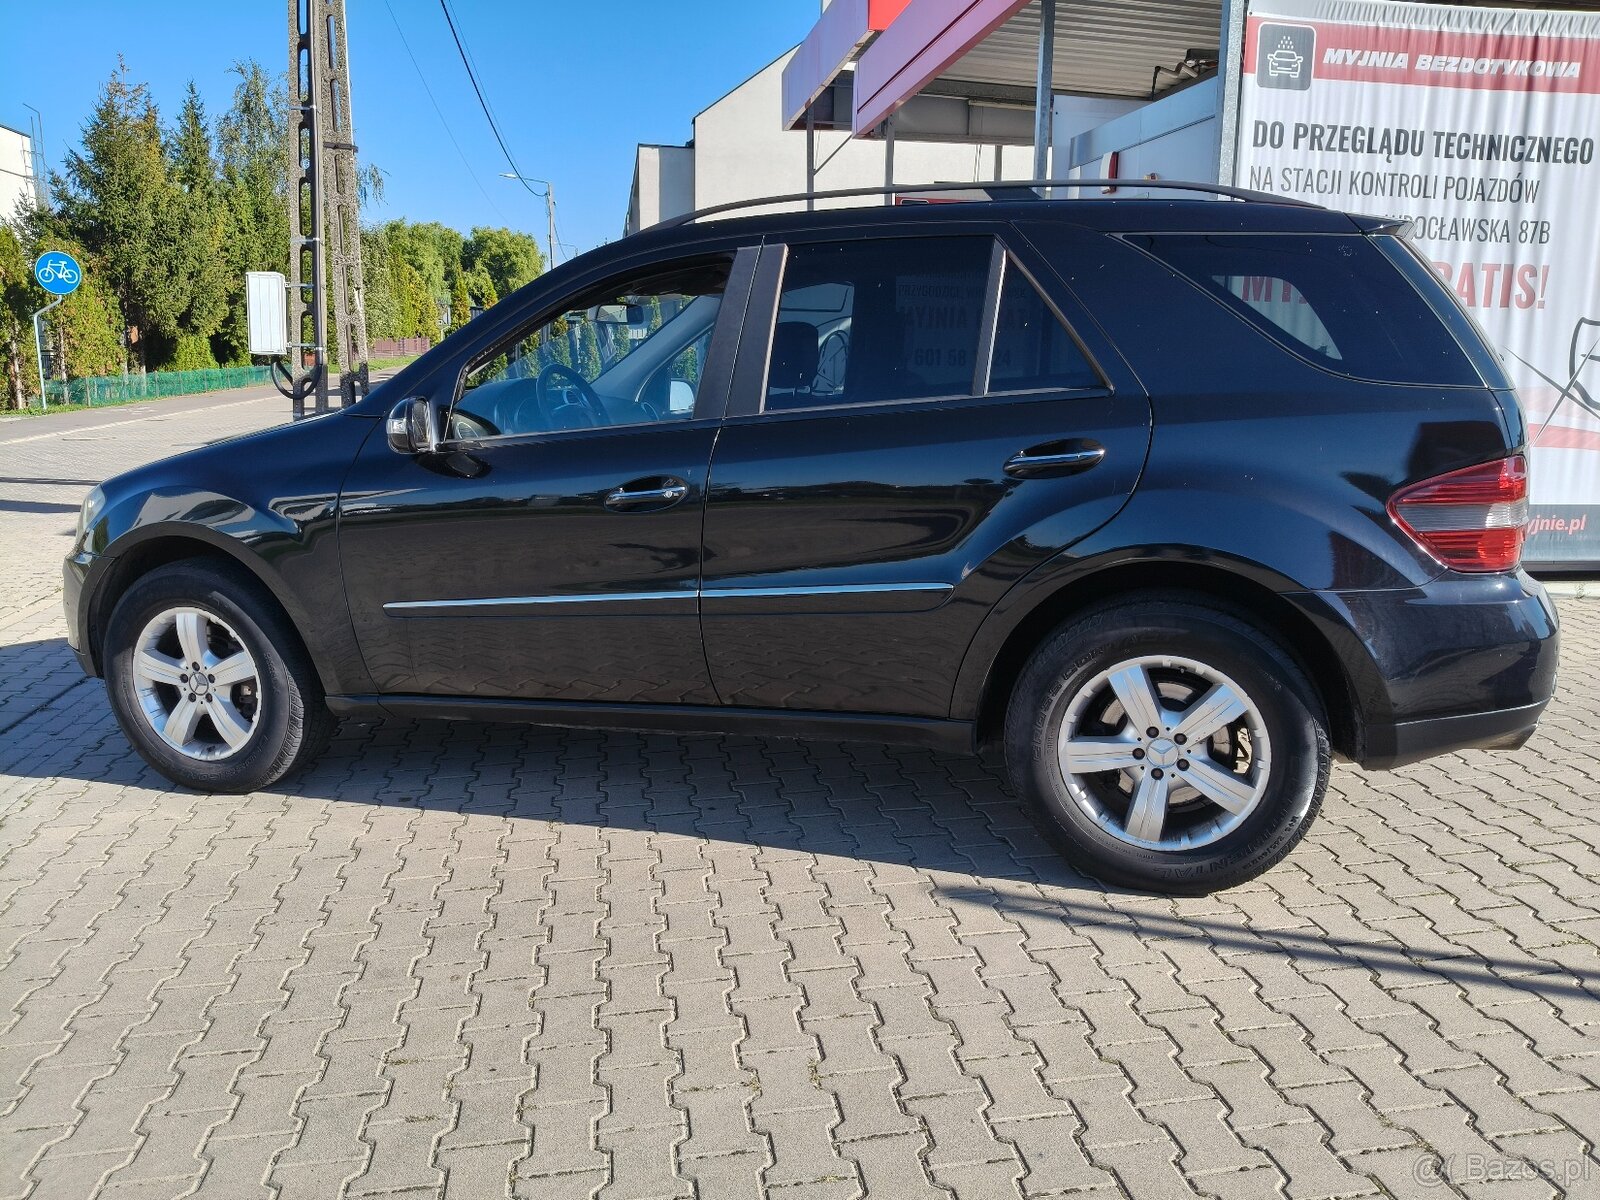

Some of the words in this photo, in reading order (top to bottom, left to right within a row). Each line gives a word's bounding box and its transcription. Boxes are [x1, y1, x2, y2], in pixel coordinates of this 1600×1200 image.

[1323, 48, 1408, 69] MYJNIA
[1415, 54, 1581, 78] BEZDOTYKOWA
[1253, 119, 1285, 149] DO
[1293, 122, 1424, 163] PRZEGLĄDU
[1433, 131, 1594, 164] TECHNICZNEGO
[1250, 166, 1273, 191] NA
[1281, 168, 1342, 194] STACJI
[1349, 170, 1438, 199] KONTROLI
[1444, 173, 1540, 203] POJAZDÓW
[1384, 214, 1510, 243] OCŁAWSKA
[1518, 220, 1550, 244] 87B
